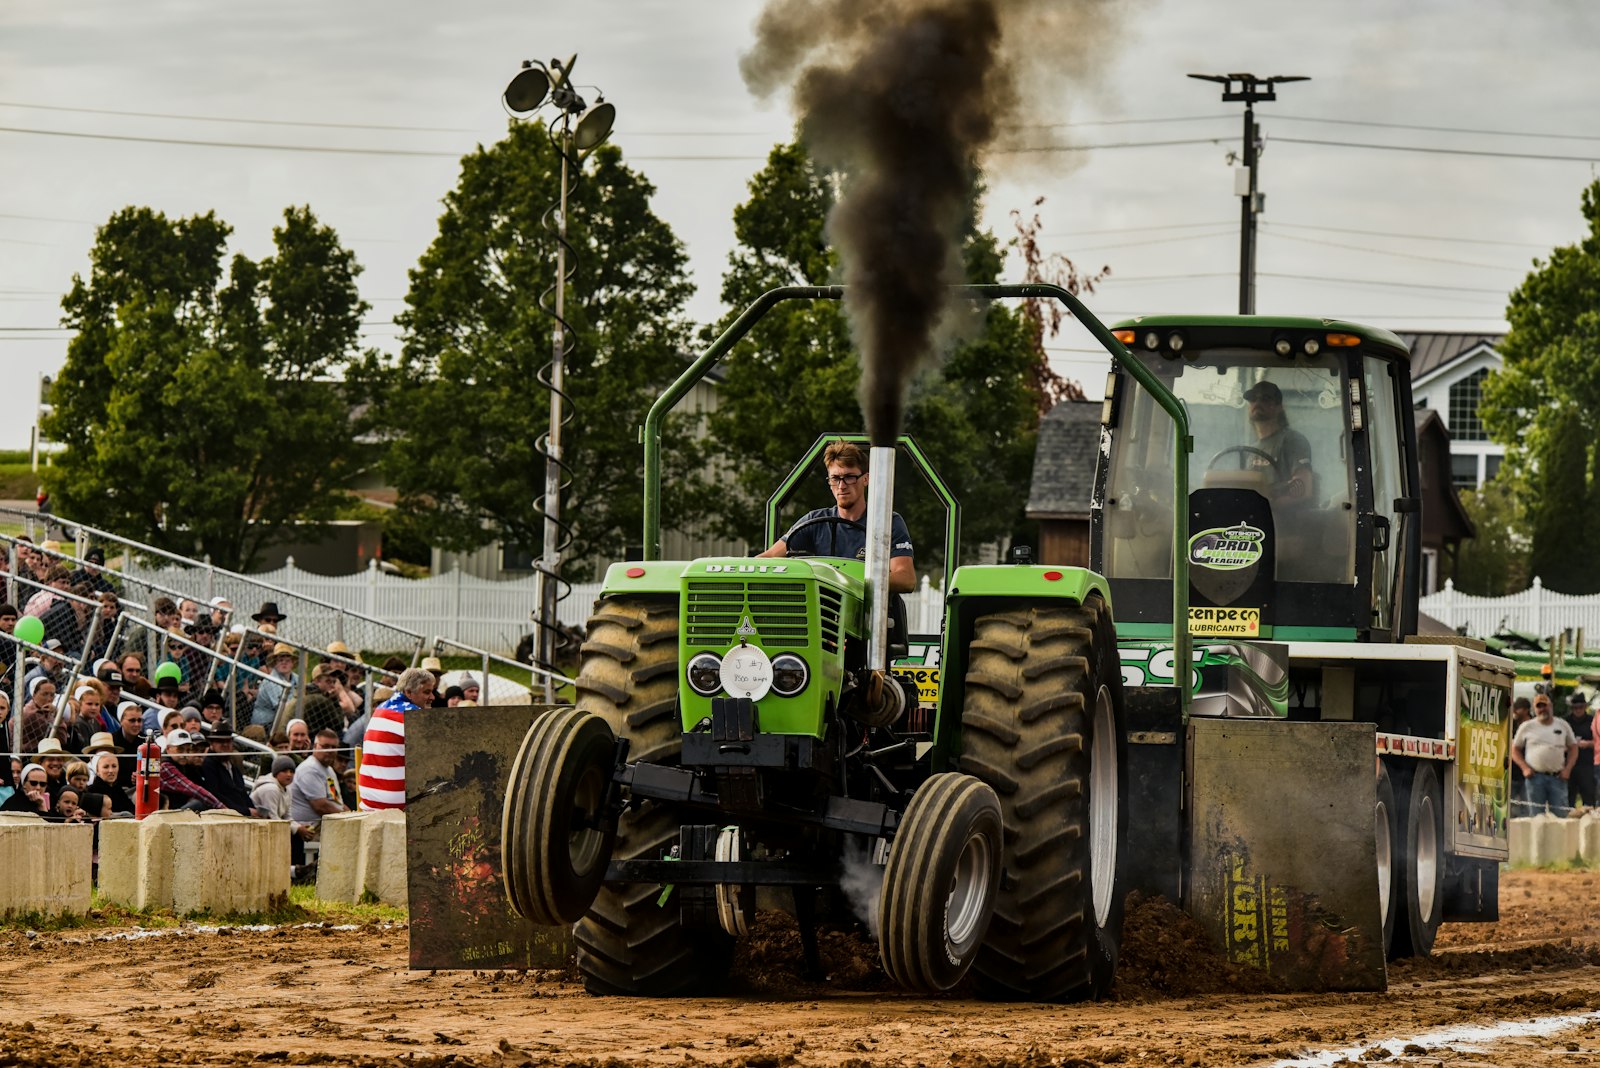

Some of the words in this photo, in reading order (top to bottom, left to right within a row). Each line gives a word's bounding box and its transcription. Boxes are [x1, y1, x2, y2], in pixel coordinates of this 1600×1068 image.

[1215, 540, 1251, 551] PRO
[1202, 549, 1259, 559] PULLING
[705, 564, 788, 574] DEUTZ
[1189, 624, 1246, 632] LUBRICANTS
[1468, 683, 1502, 725] TRACK
[1469, 728, 1499, 768] BOSS
